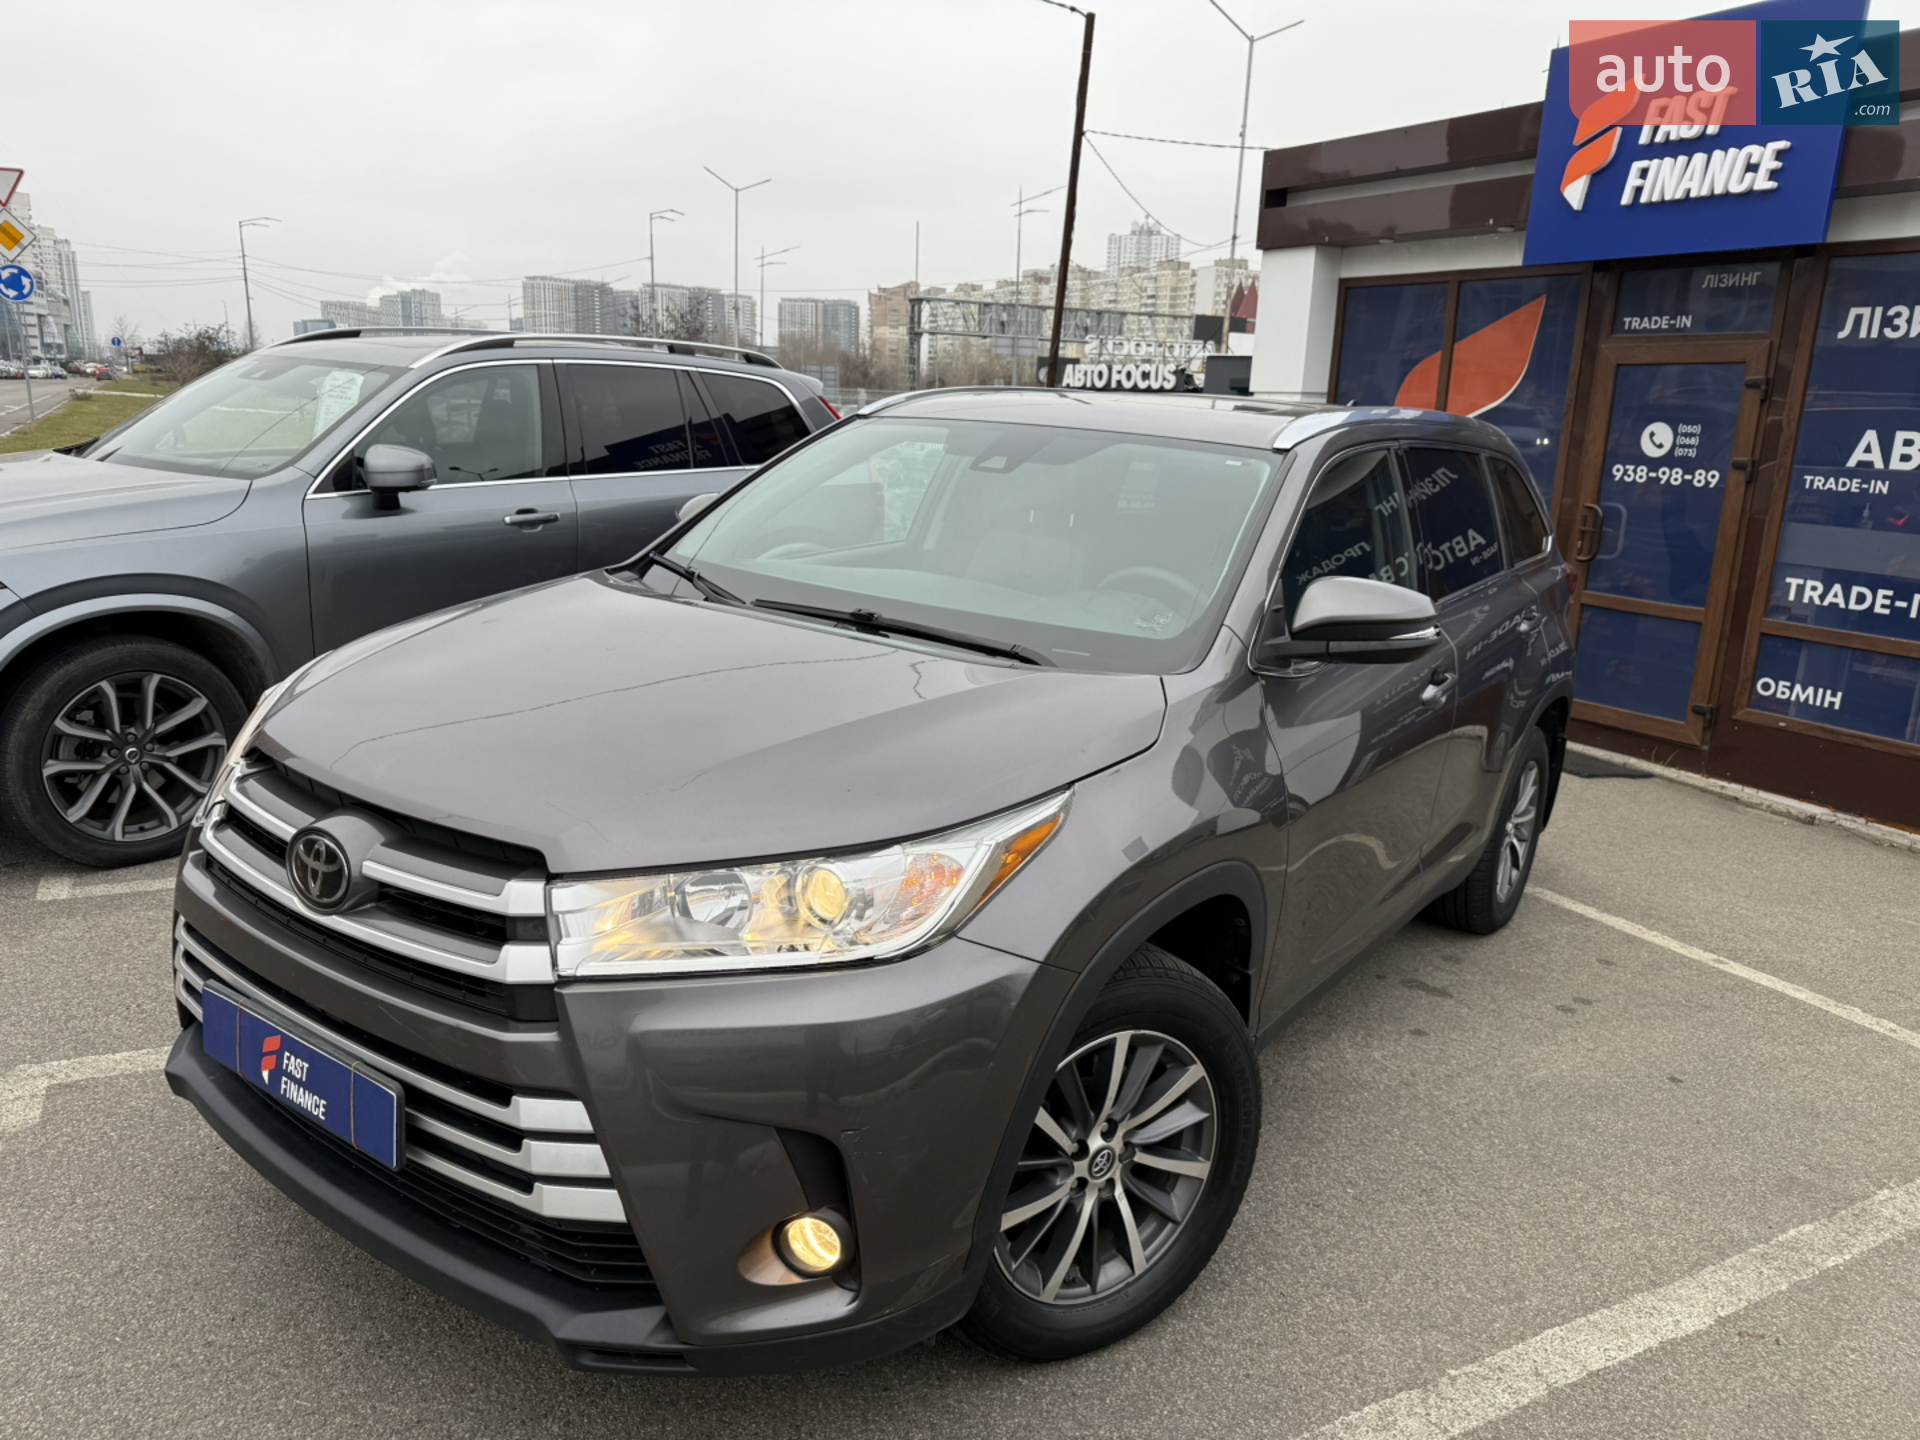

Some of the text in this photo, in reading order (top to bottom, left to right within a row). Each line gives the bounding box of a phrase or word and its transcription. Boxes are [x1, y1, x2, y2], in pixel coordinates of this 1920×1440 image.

[1638, 86, 1739, 145] FAST
[1620, 140, 1792, 206] FINANCE
[1701, 271, 1762, 288] ЛІЗИНГ
[1623, 315, 1692, 330] TRADE-IN
[1061, 363, 1177, 390] АВТО FOCUS
[1676, 435, 1700, 447] (068)
[1678, 423, 1702, 435] (050)
[1674, 447, 1697, 458] (073)
[1612, 464, 1720, 488] 938-98-89
[1803, 475, 1890, 495] TRADE-IN
[1756, 677, 1843, 710] ОБМІН
[282, 1051, 309, 1082] FAST
[280, 1076, 327, 1120] FINANCE
